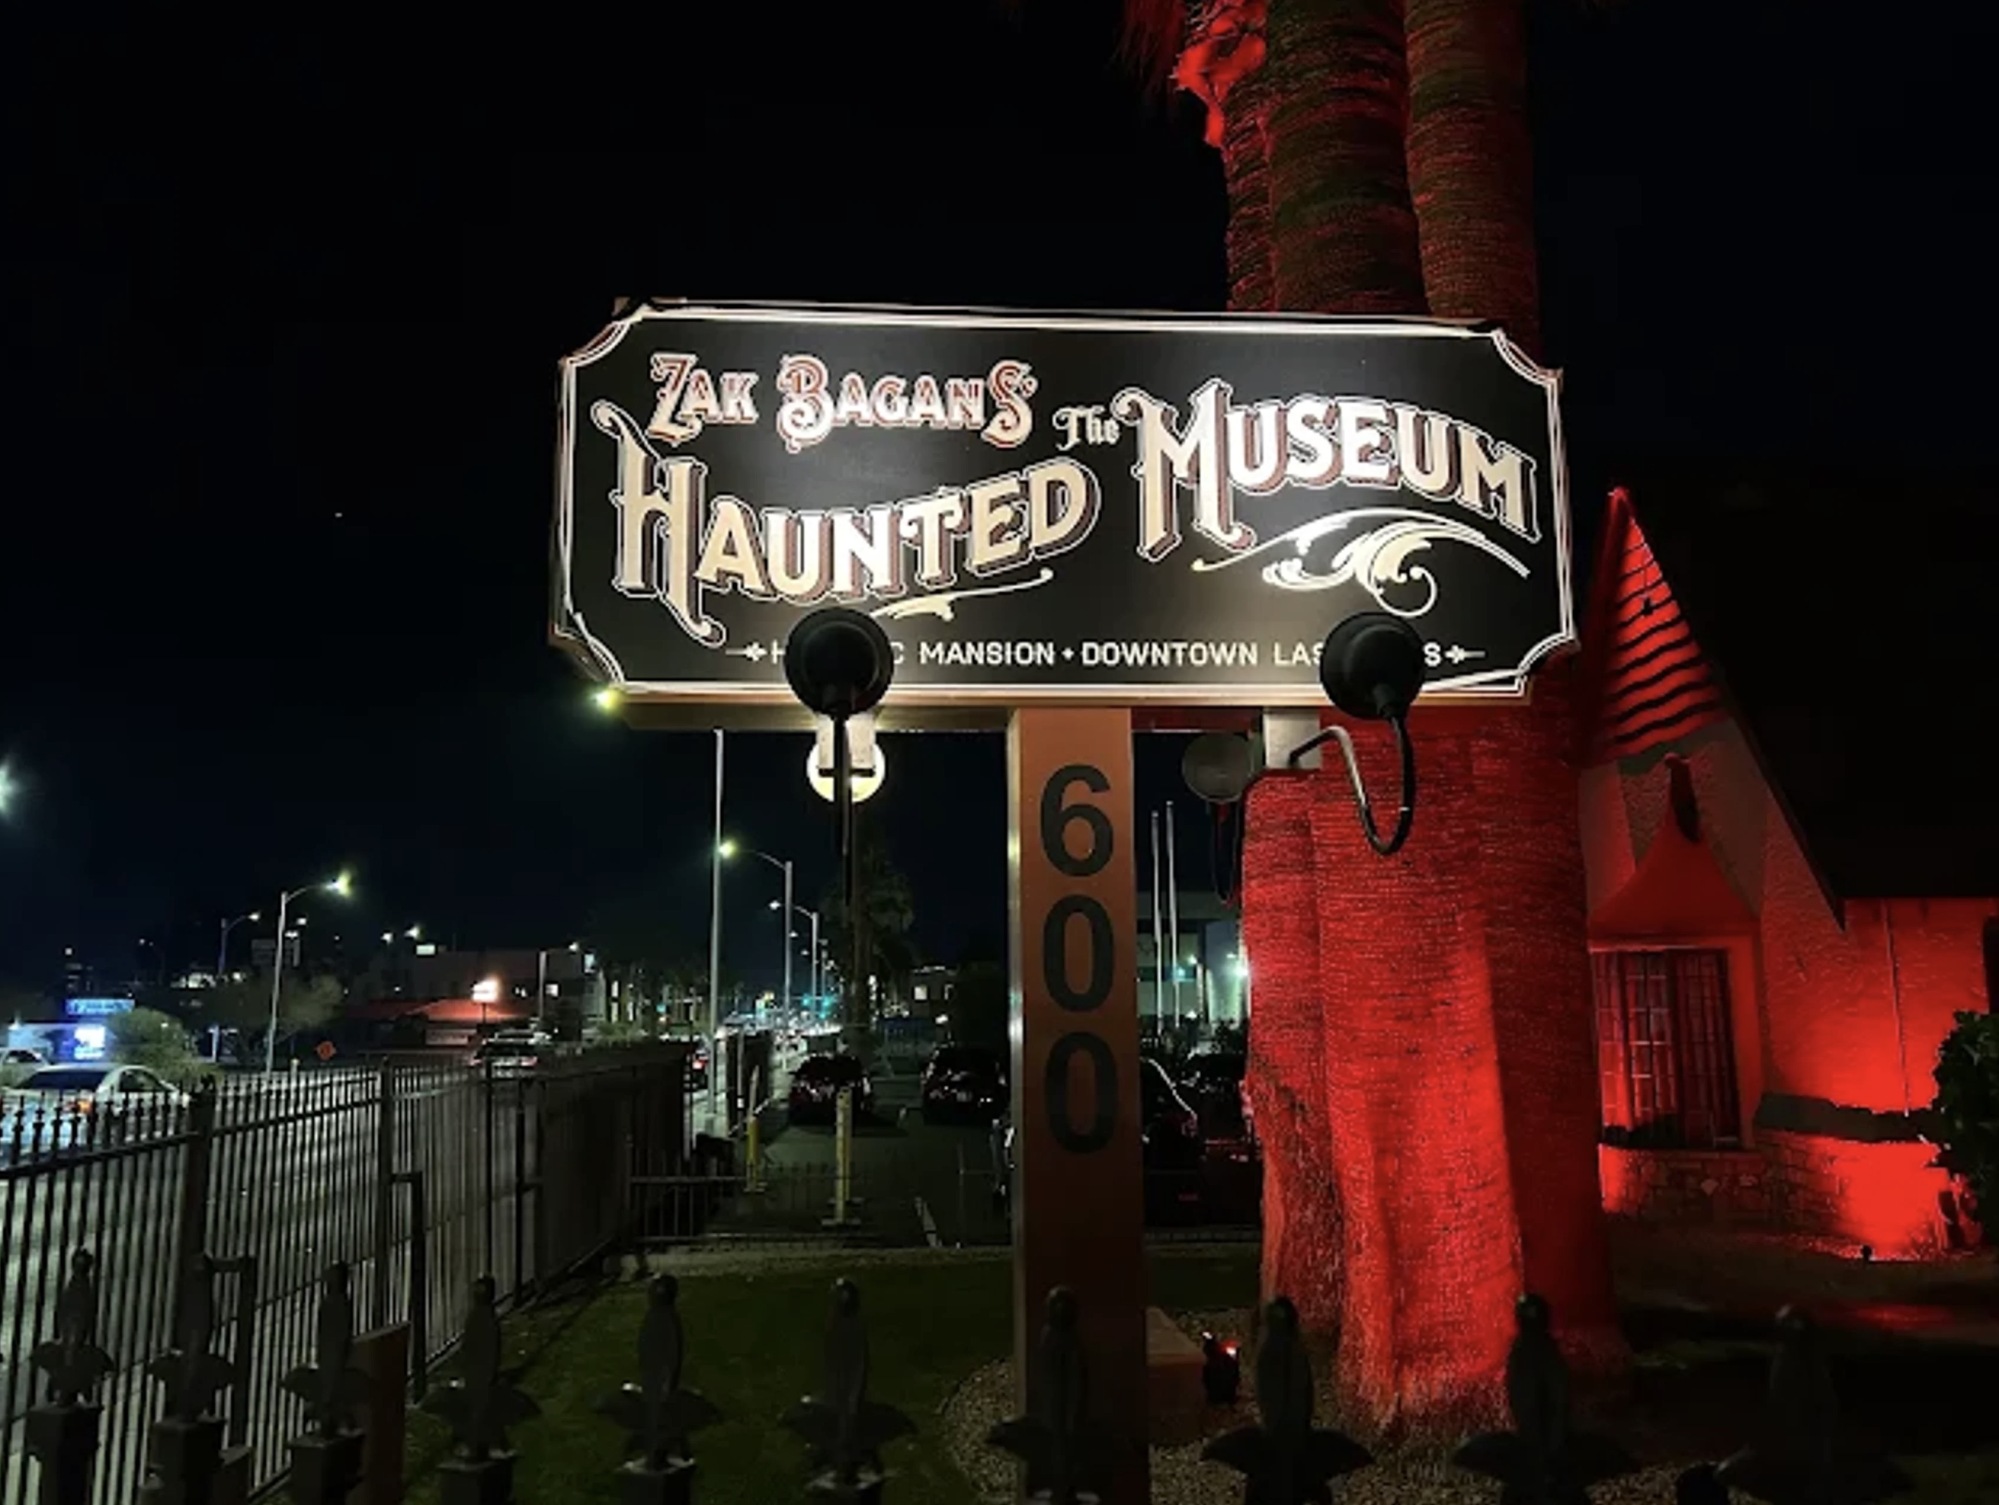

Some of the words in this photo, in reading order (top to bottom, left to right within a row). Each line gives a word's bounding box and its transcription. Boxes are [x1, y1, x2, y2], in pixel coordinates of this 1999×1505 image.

[646, 353, 760, 447] ZAK
[775, 354, 1039, 454] BAGANS
[1051, 404, 1121, 452] The
[591, 400, 1101, 646] HAUNTED
[1110, 377, 1543, 563] MUSEUM
[919, 640, 1056, 666] MANSION
[1080, 640, 1259, 668] DOWNTOWN
[1039, 763, 1119, 1156] 600
